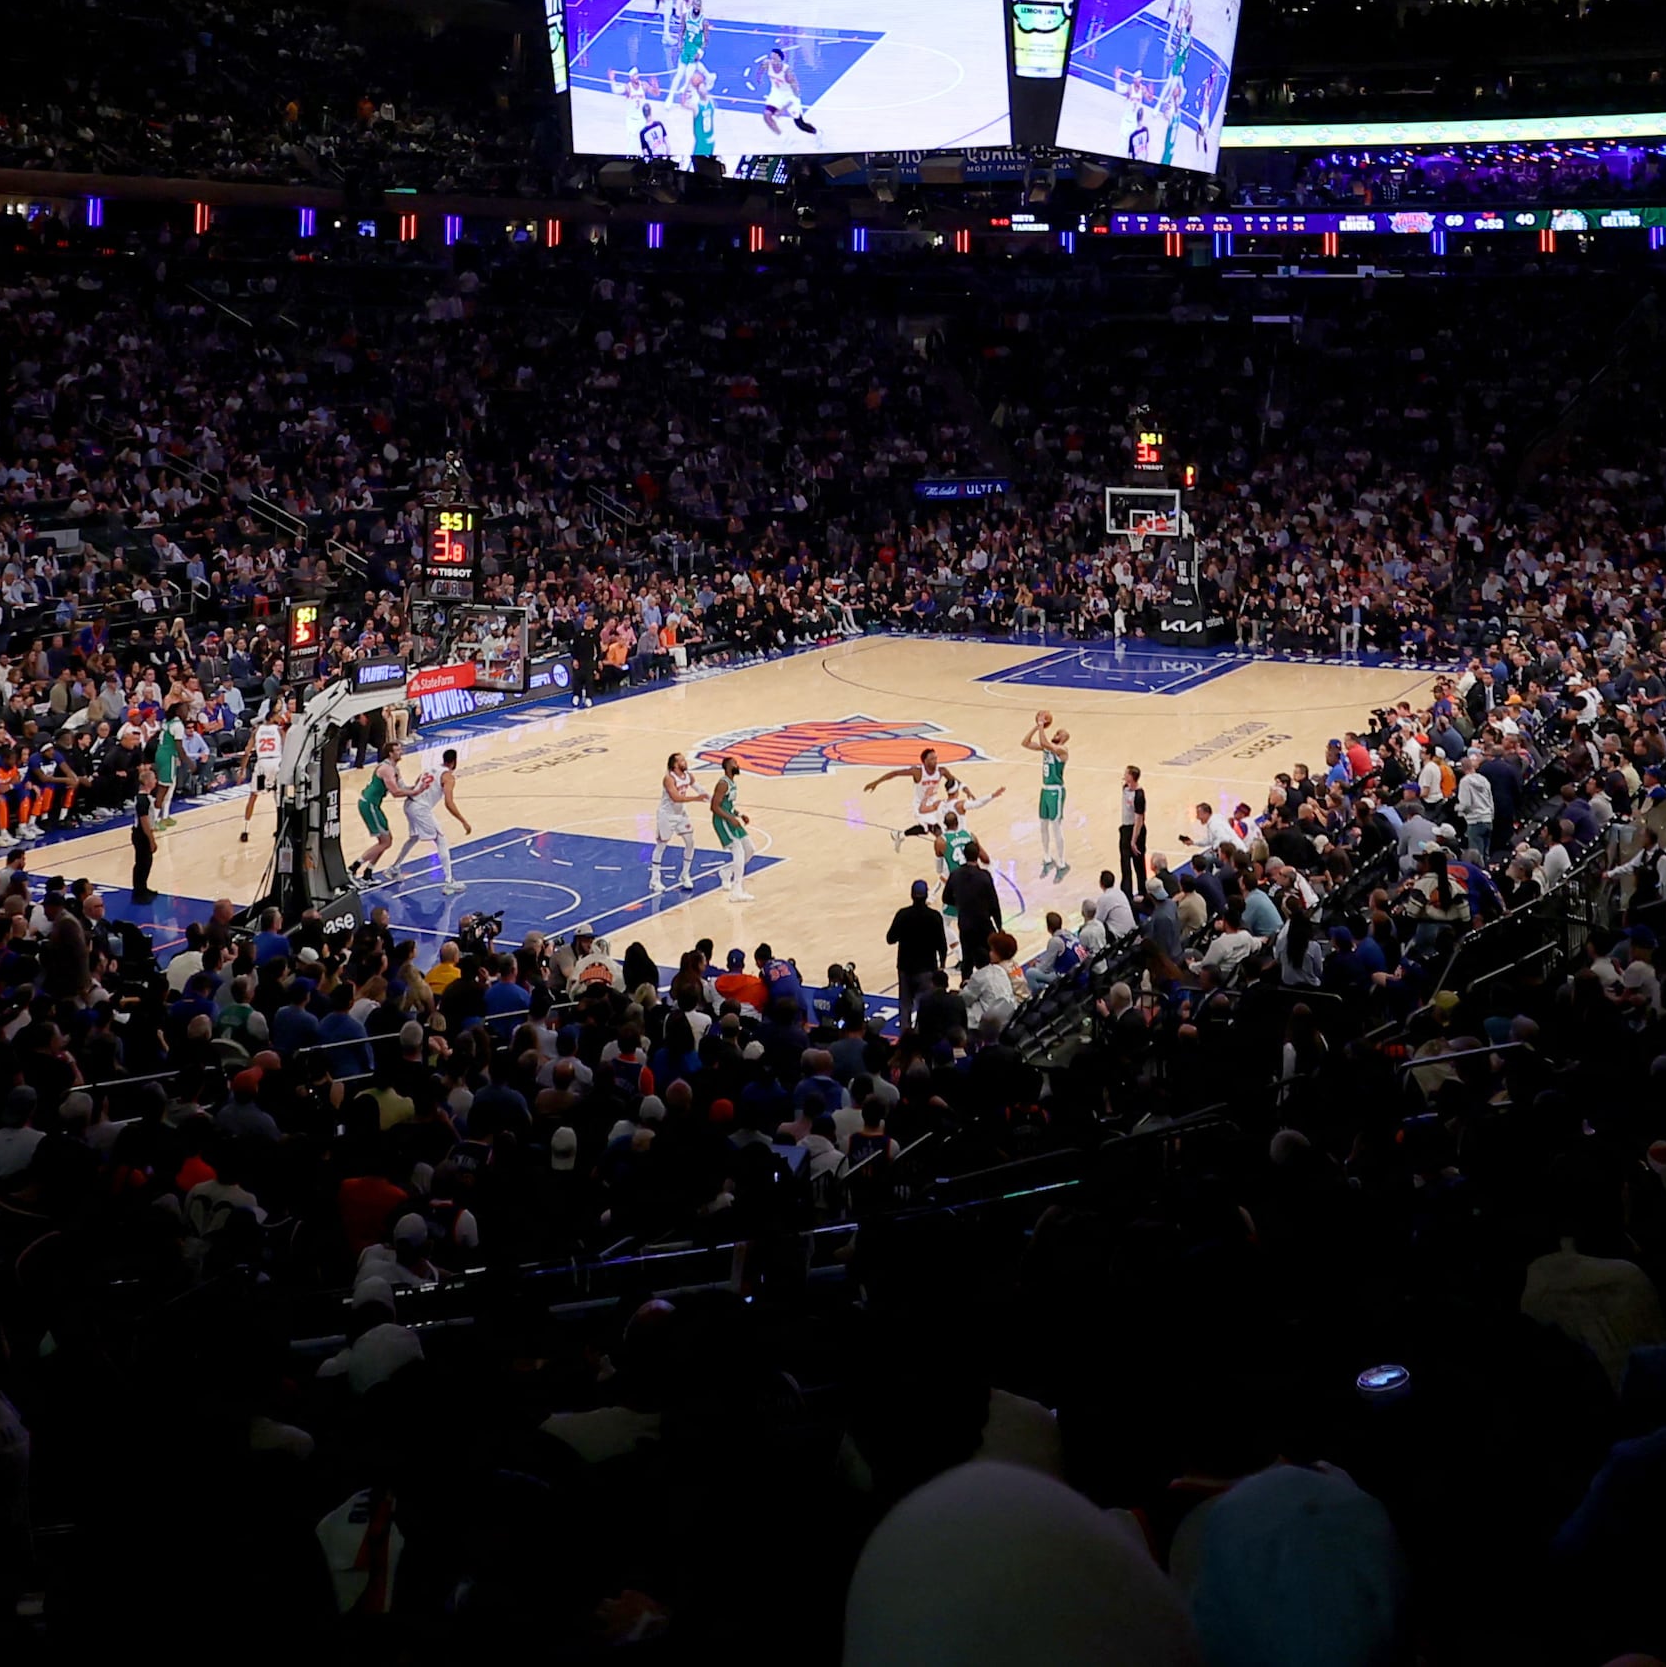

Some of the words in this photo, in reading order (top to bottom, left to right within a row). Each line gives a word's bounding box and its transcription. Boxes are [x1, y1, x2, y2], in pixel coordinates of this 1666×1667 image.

[966, 165, 993, 173] MOST
[1080, 215, 1085, 223] 1
[1445, 215, 1464, 226] 69
[1475, 218, 1504, 230] 9:52
[1516, 213, 1535, 225] 40
[1601, 216, 1641, 227] CELTICS
[1078, 224, 1086, 232] 6
[1339, 220, 1375, 231] KNICKS
[440, 512, 472, 531] 9:51
[434, 530, 464, 562] 3.8
[439, 568, 472, 578] TISSOT
[1173, 598, 1193, 606] Google
[296, 646, 319, 656] TISSOT
[530, 673, 551, 688] ESPN
[554, 672, 567, 681] TNT
[421, 690, 474, 722] PLAYOFFS
[475, 692, 505, 706] Google
[259, 738, 275, 753] 25
[513, 752, 589, 773] CHASE
[952, 847, 966, 865] 4
